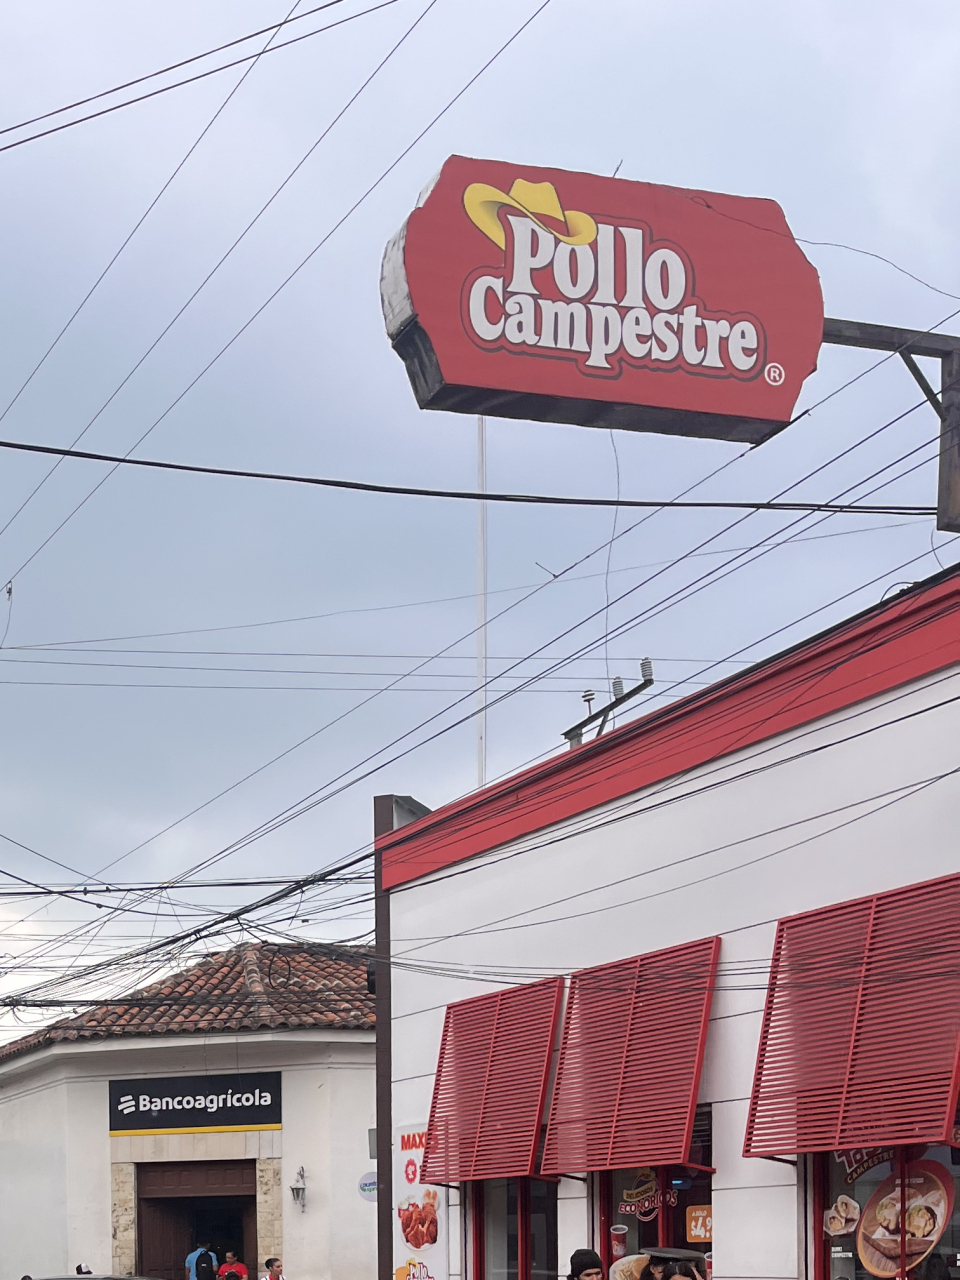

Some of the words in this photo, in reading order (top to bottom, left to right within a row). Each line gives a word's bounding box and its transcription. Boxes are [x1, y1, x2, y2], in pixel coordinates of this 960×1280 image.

[507, 213, 686, 311] Pollo
[469, 275, 758, 369] Campestre
[139, 1088, 272, 1112] Bancoagrícola
[846, 1149, 895, 1184] CAMPESTRE
